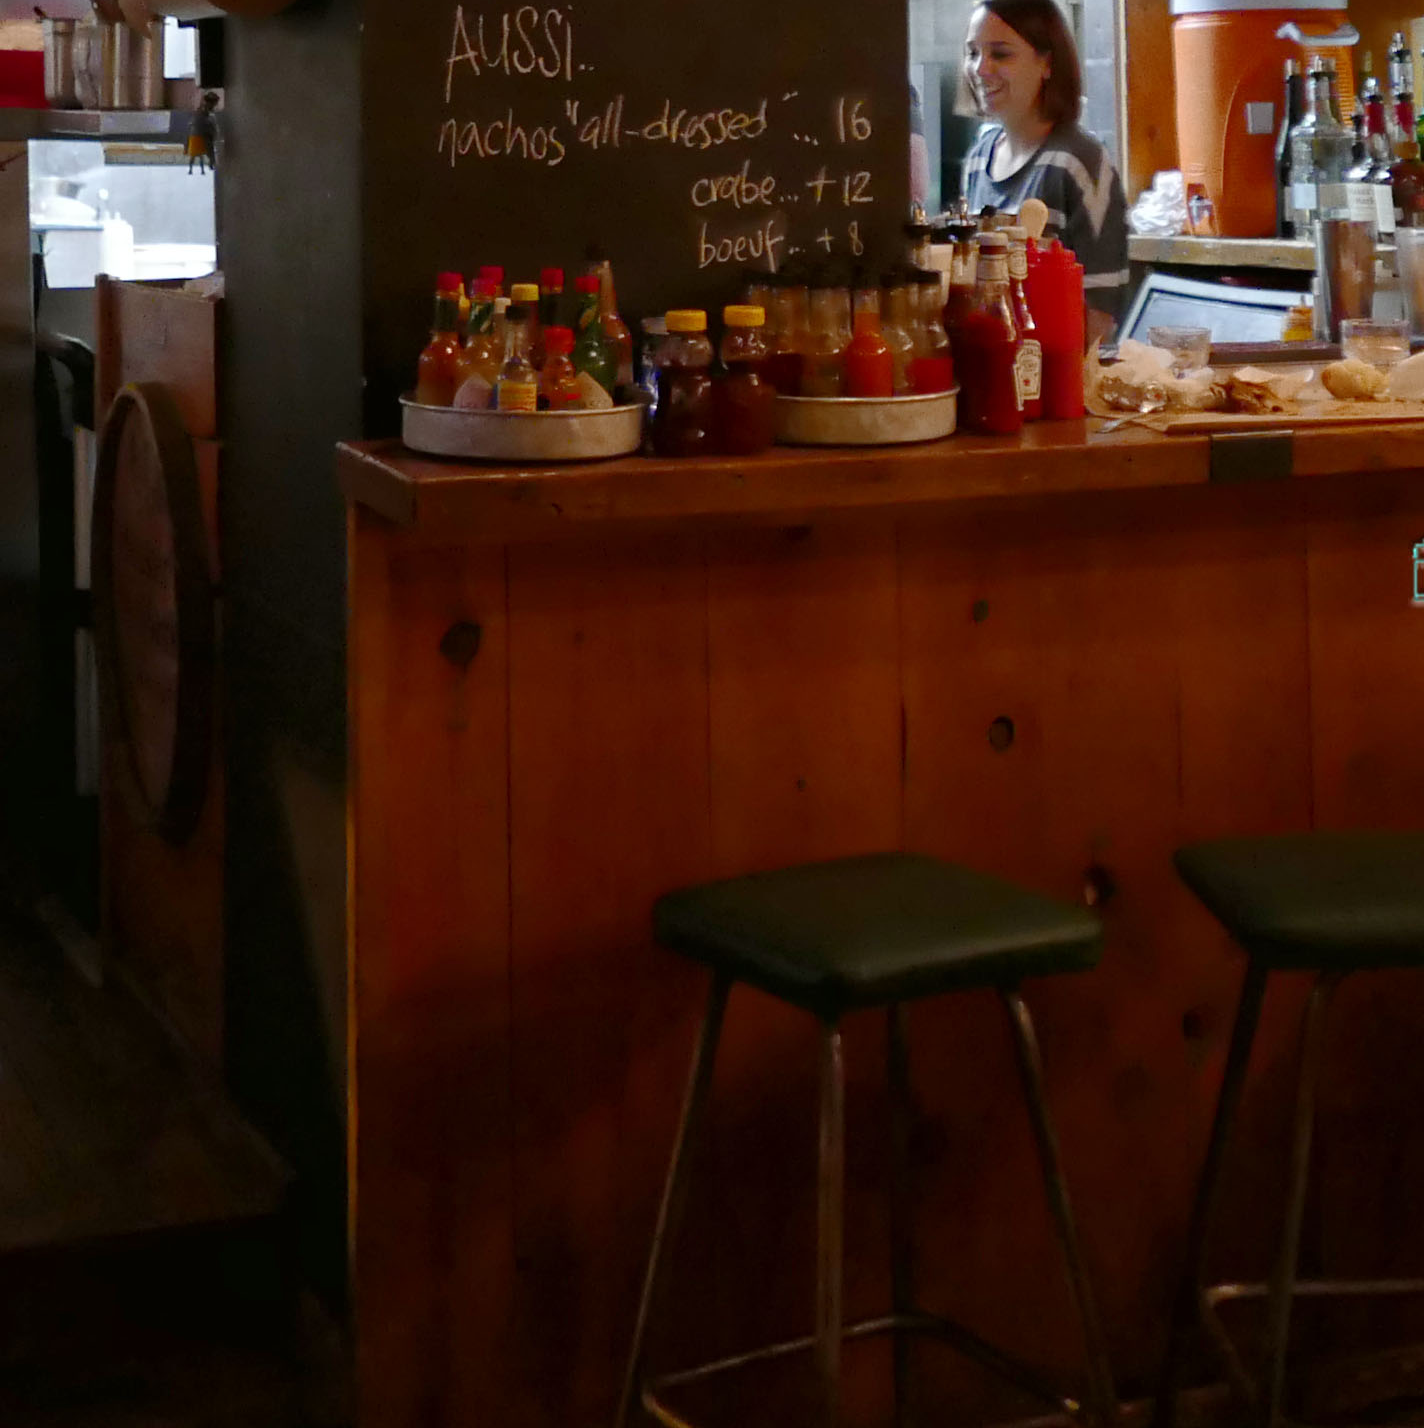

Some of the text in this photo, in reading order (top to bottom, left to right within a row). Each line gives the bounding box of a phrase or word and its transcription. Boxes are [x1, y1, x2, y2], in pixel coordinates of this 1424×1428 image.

[436, 107, 568, 170] nachos
[833, 96, 873, 146] 16
[845, 220, 865, 256] 8
